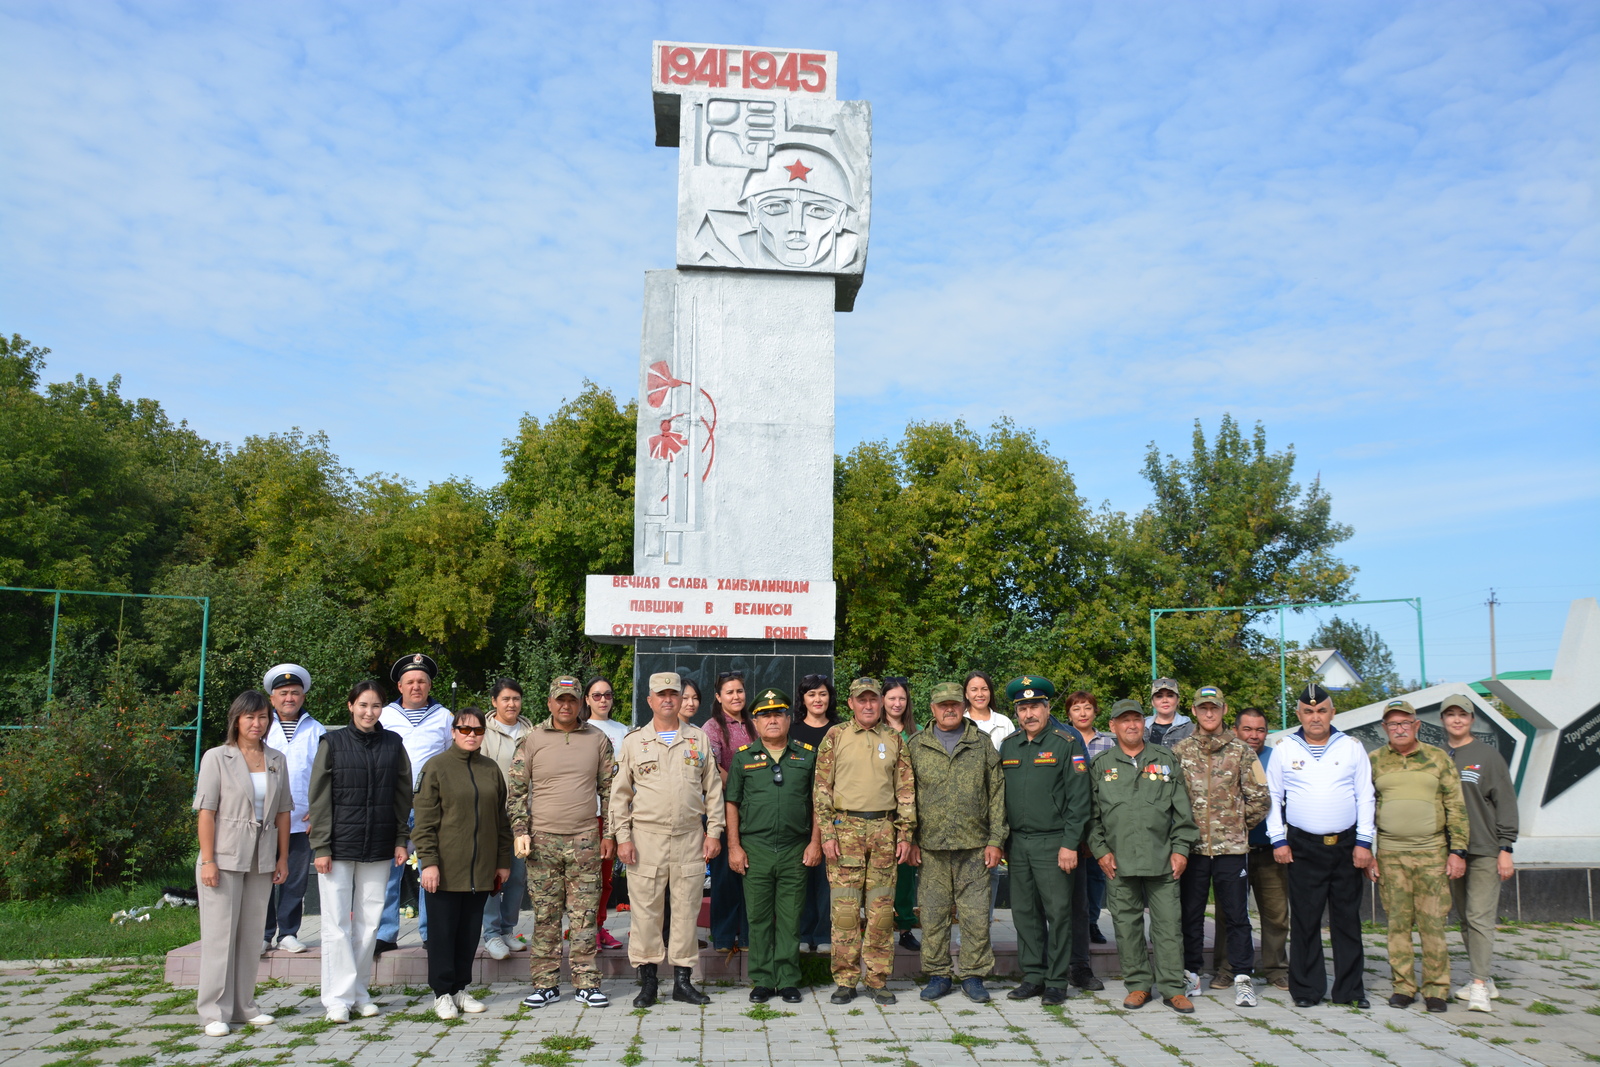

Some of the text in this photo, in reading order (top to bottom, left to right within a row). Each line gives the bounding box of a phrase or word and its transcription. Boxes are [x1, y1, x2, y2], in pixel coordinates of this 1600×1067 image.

[660, 45, 827, 93] 1941-1945
[612, 575, 660, 589] ВЕЧНАЯ
[668, 576, 708, 589] СЛАВА
[629, 599, 684, 613] ПАВШИМ
[704, 601, 714, 614] В
